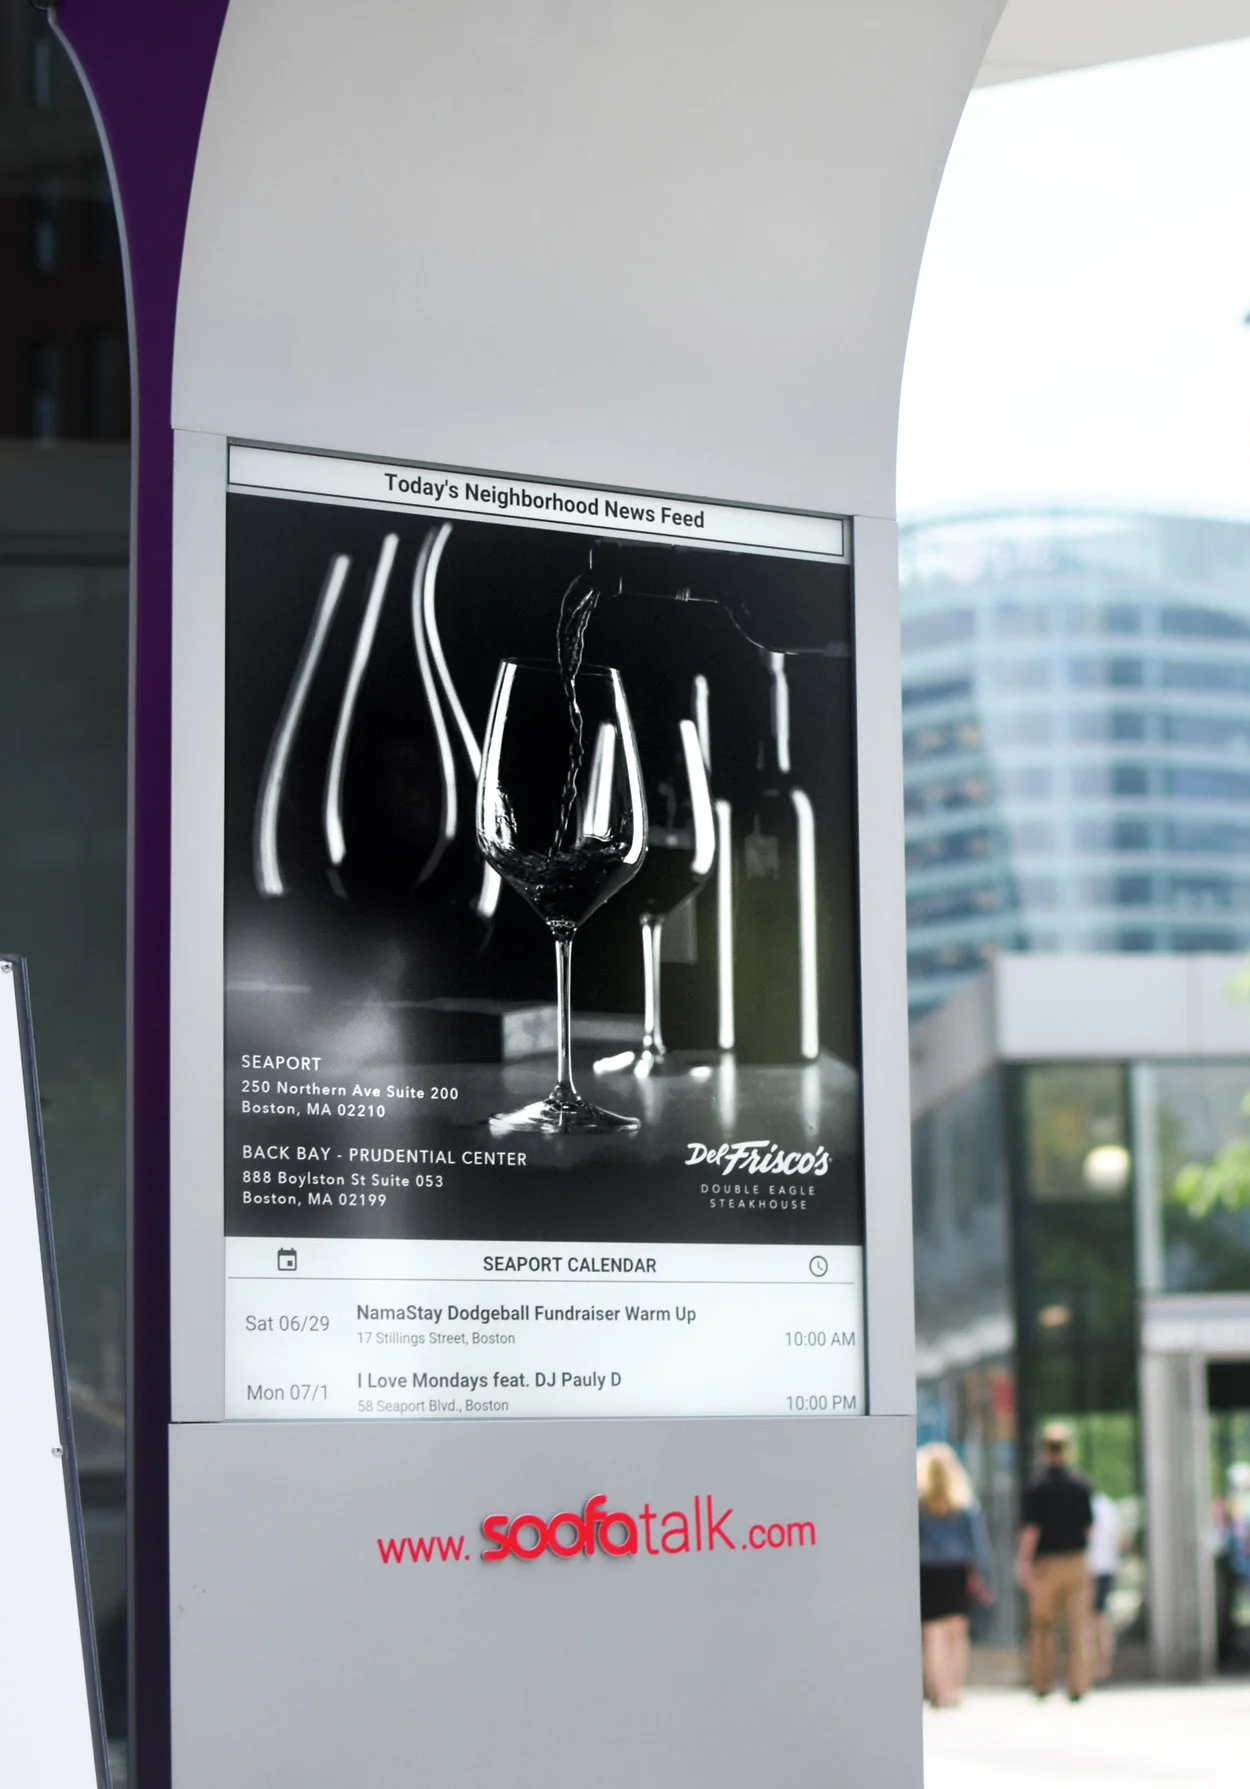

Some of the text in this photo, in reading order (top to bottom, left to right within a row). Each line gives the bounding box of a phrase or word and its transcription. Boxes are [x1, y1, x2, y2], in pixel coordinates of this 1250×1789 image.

[383, 472, 705, 529] Today's Neighborhood News Feed
[241, 1054, 322, 1072] SEAPORT
[241, 1079, 459, 1100] 250 Northern Ave Suite 200
[241, 1100, 387, 1118] Boston, MA 02210
[242, 1144, 290, 1160] BACK
[296, 1146, 331, 1161] BAY
[349, 1147, 456, 1164] PRUDENTIAL
[461, 1151, 527, 1166] CENTER
[242, 1170, 443, 1188] 888 Boylston St Suite 053
[242, 1190, 387, 1207] Boston, MA 02199
[700, 1183, 815, 1196] DOUBLE EAGLE
[709, 1198, 806, 1210] STEAKHOUSE
[483, 1255, 657, 1273] SEAPORT CALENDAR
[245, 1314, 330, 1333] Sat 06/29
[357, 1304, 697, 1325] NamaStay Dodgeball Fundraiser Warm Up
[357, 1331, 516, 1345] 17 Stillings Street, Boston
[785, 1331, 856, 1347] 10:00 AM
[357, 1371, 622, 1392] I Love Mondays feat. DJ Pauly D
[247, 1383, 327, 1401] Mon 07/1
[358, 1398, 509, 1415] 58 Seaport Blvd., Boston
[786, 1395, 857, 1411] 10:00 PM
